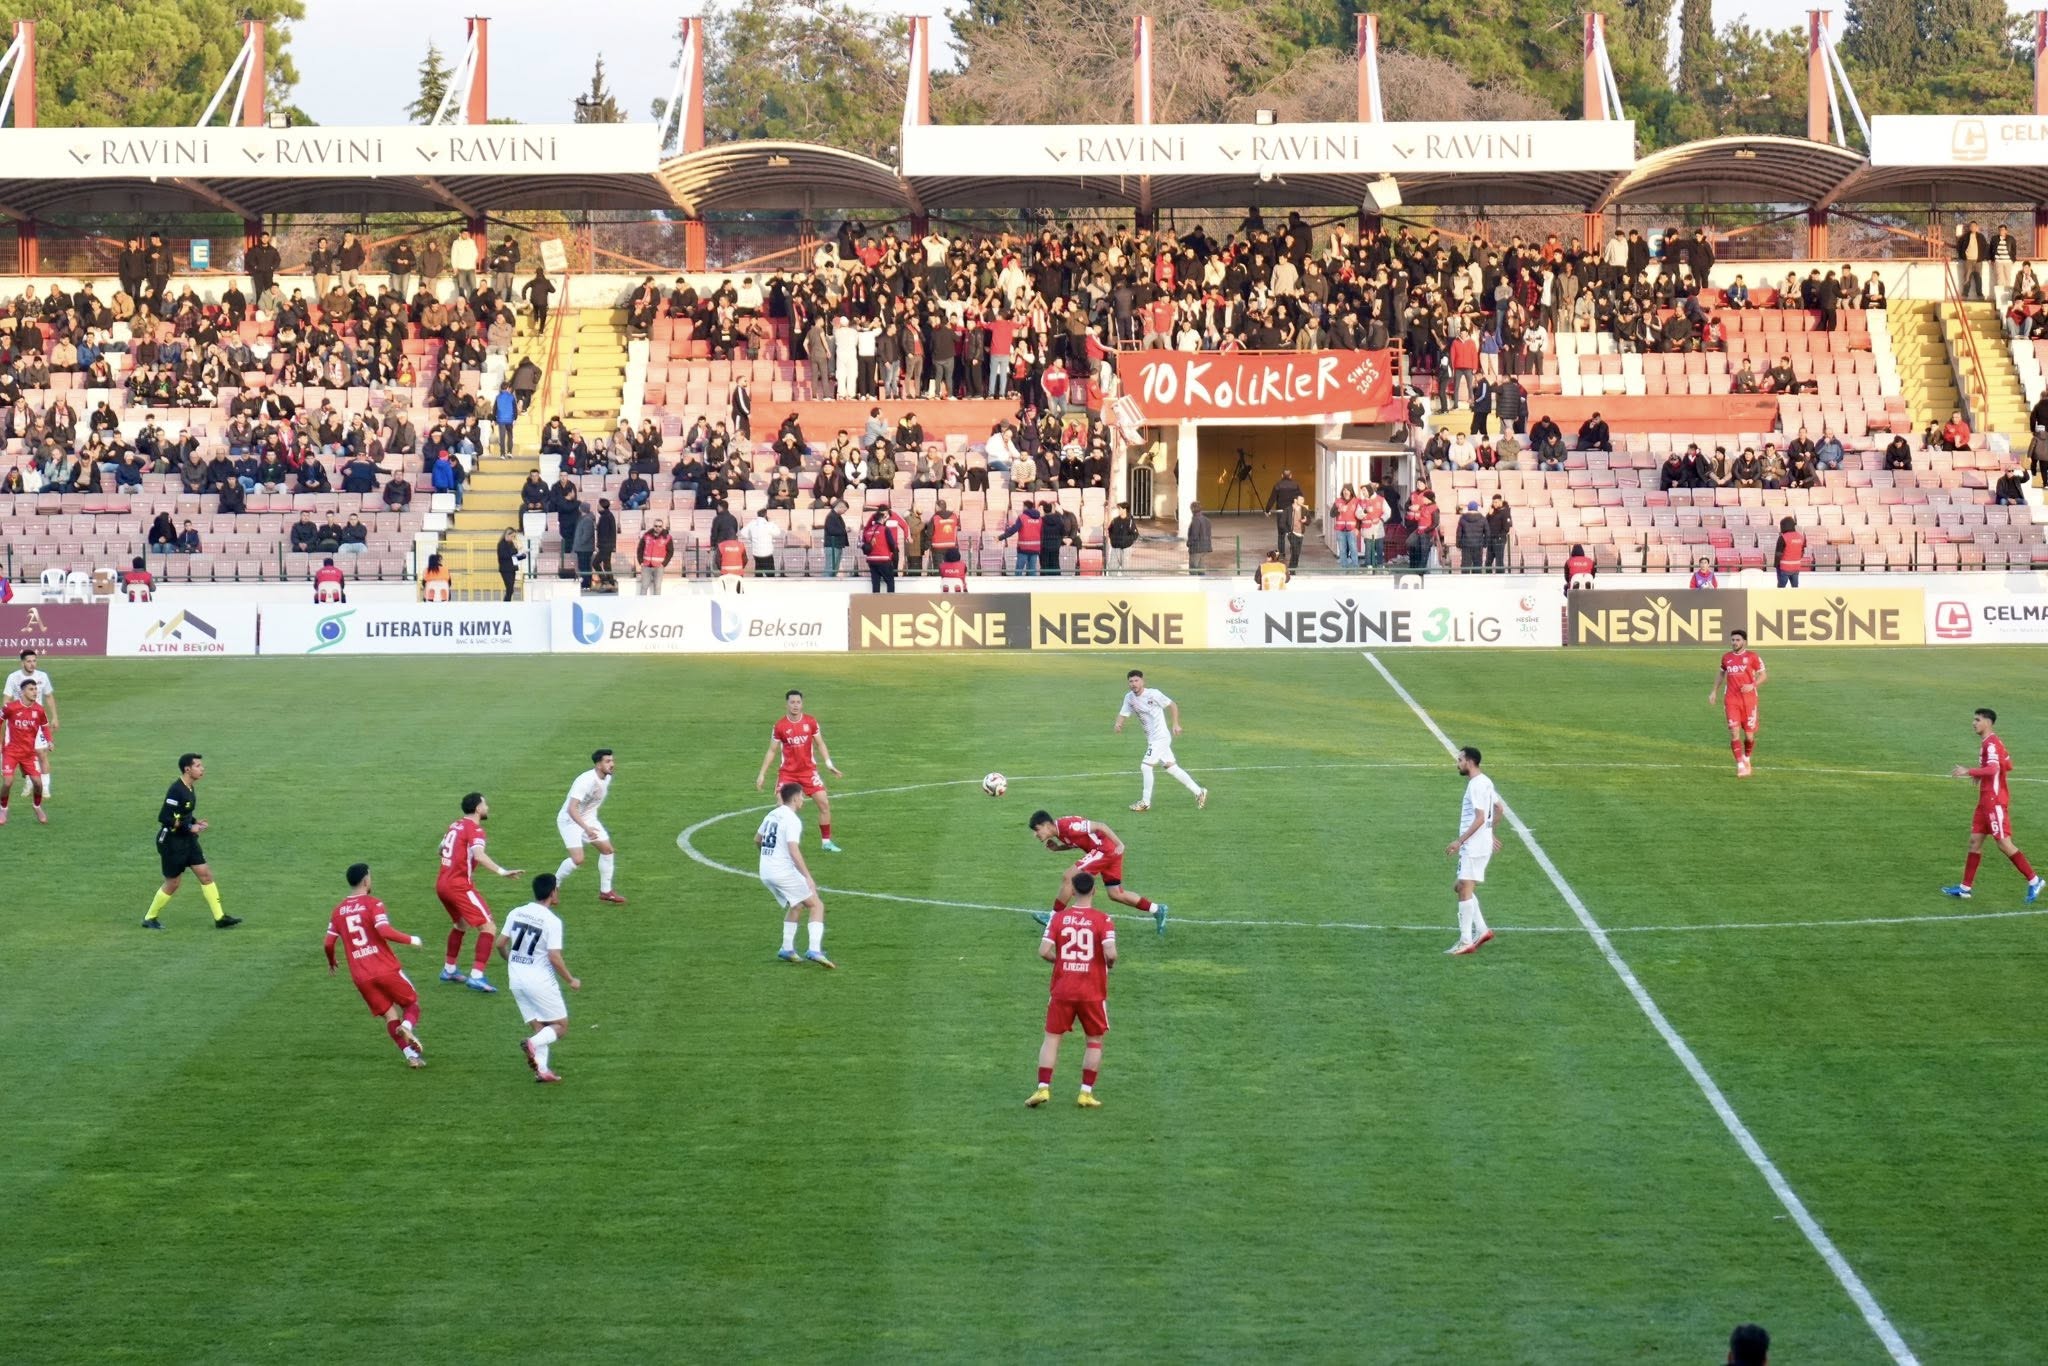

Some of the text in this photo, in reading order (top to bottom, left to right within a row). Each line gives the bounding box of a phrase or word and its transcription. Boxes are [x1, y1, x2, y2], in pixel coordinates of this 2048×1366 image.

[193, 246, 208, 262] E
[1139, 361, 1178, 404] 10
[610, 620, 684, 639] Beksan
[749, 617, 822, 638] Beksan
[139, 643, 178, 653] ALTIN
[345, 914, 368, 947] 5
[511, 919, 543, 957] 77
[1060, 926, 1094, 961] 29
